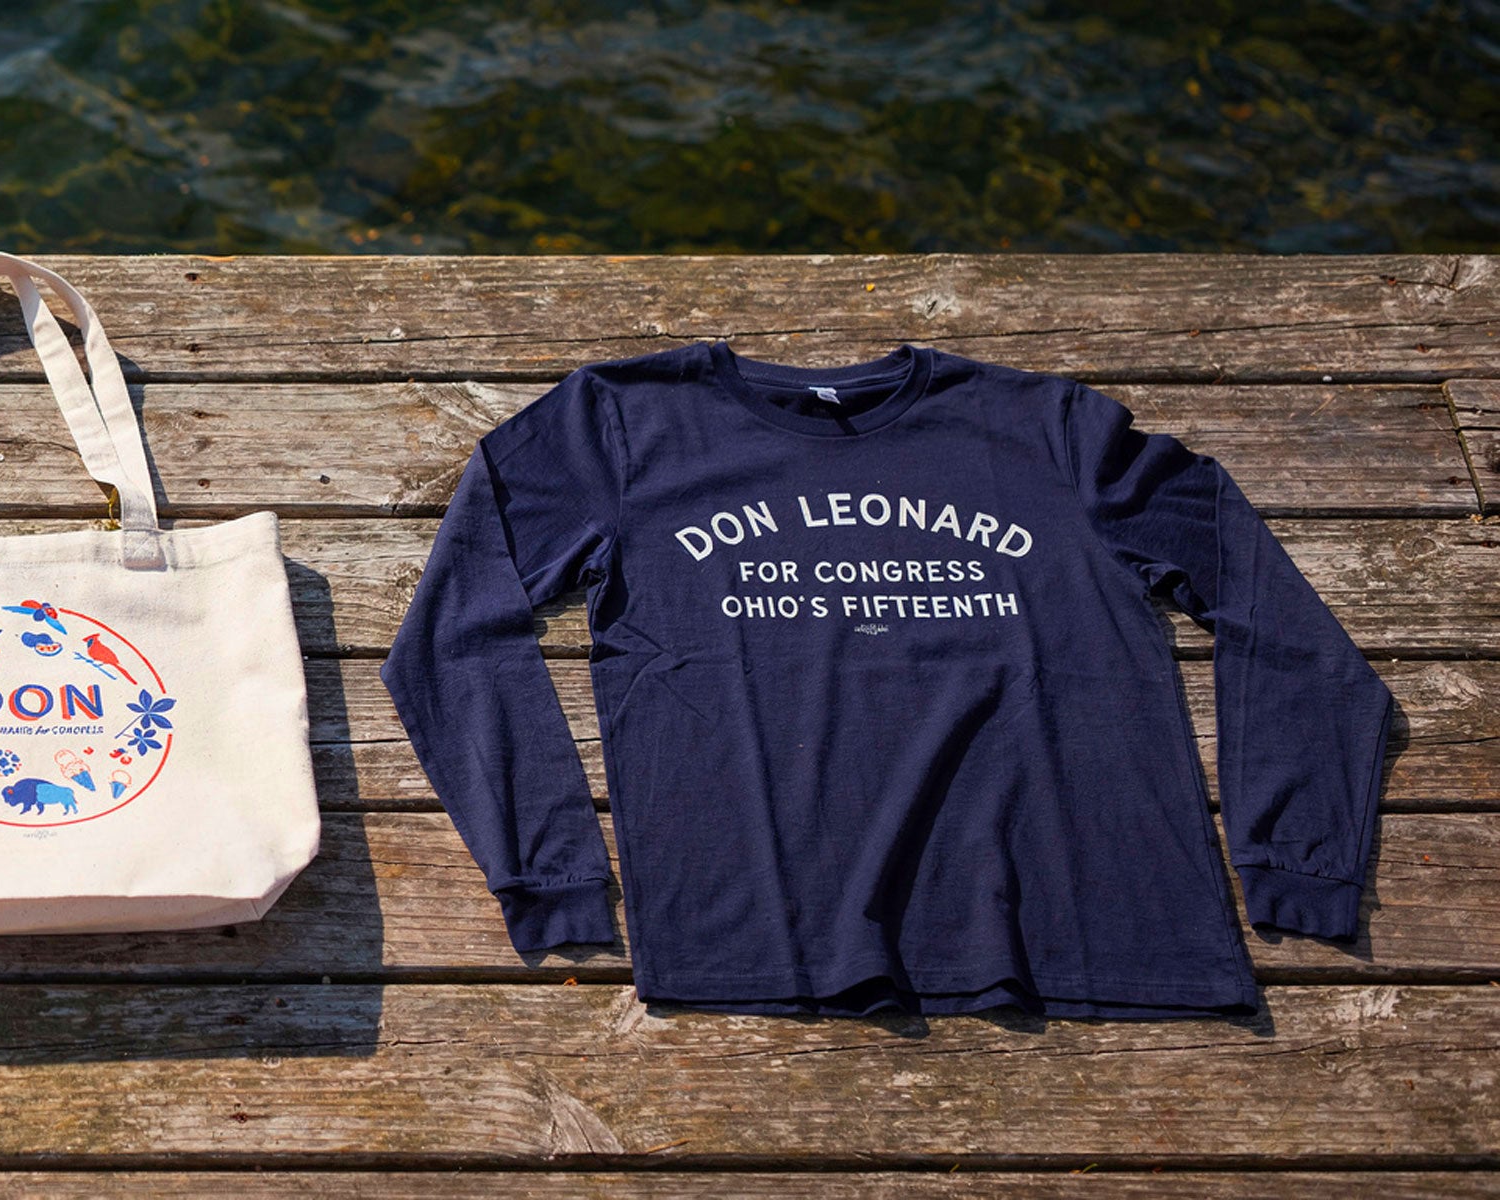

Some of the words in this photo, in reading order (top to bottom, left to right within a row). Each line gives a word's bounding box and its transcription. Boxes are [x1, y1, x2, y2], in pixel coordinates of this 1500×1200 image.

[674, 501, 779, 561] DON
[798, 493, 1033, 557] LEONARD
[739, 561, 799, 583] FOR
[814, 560, 985, 583] CONGRESS
[721, 595, 829, 619] OHIO'S
[841, 593, 1019, 618] FIFTEENTH
